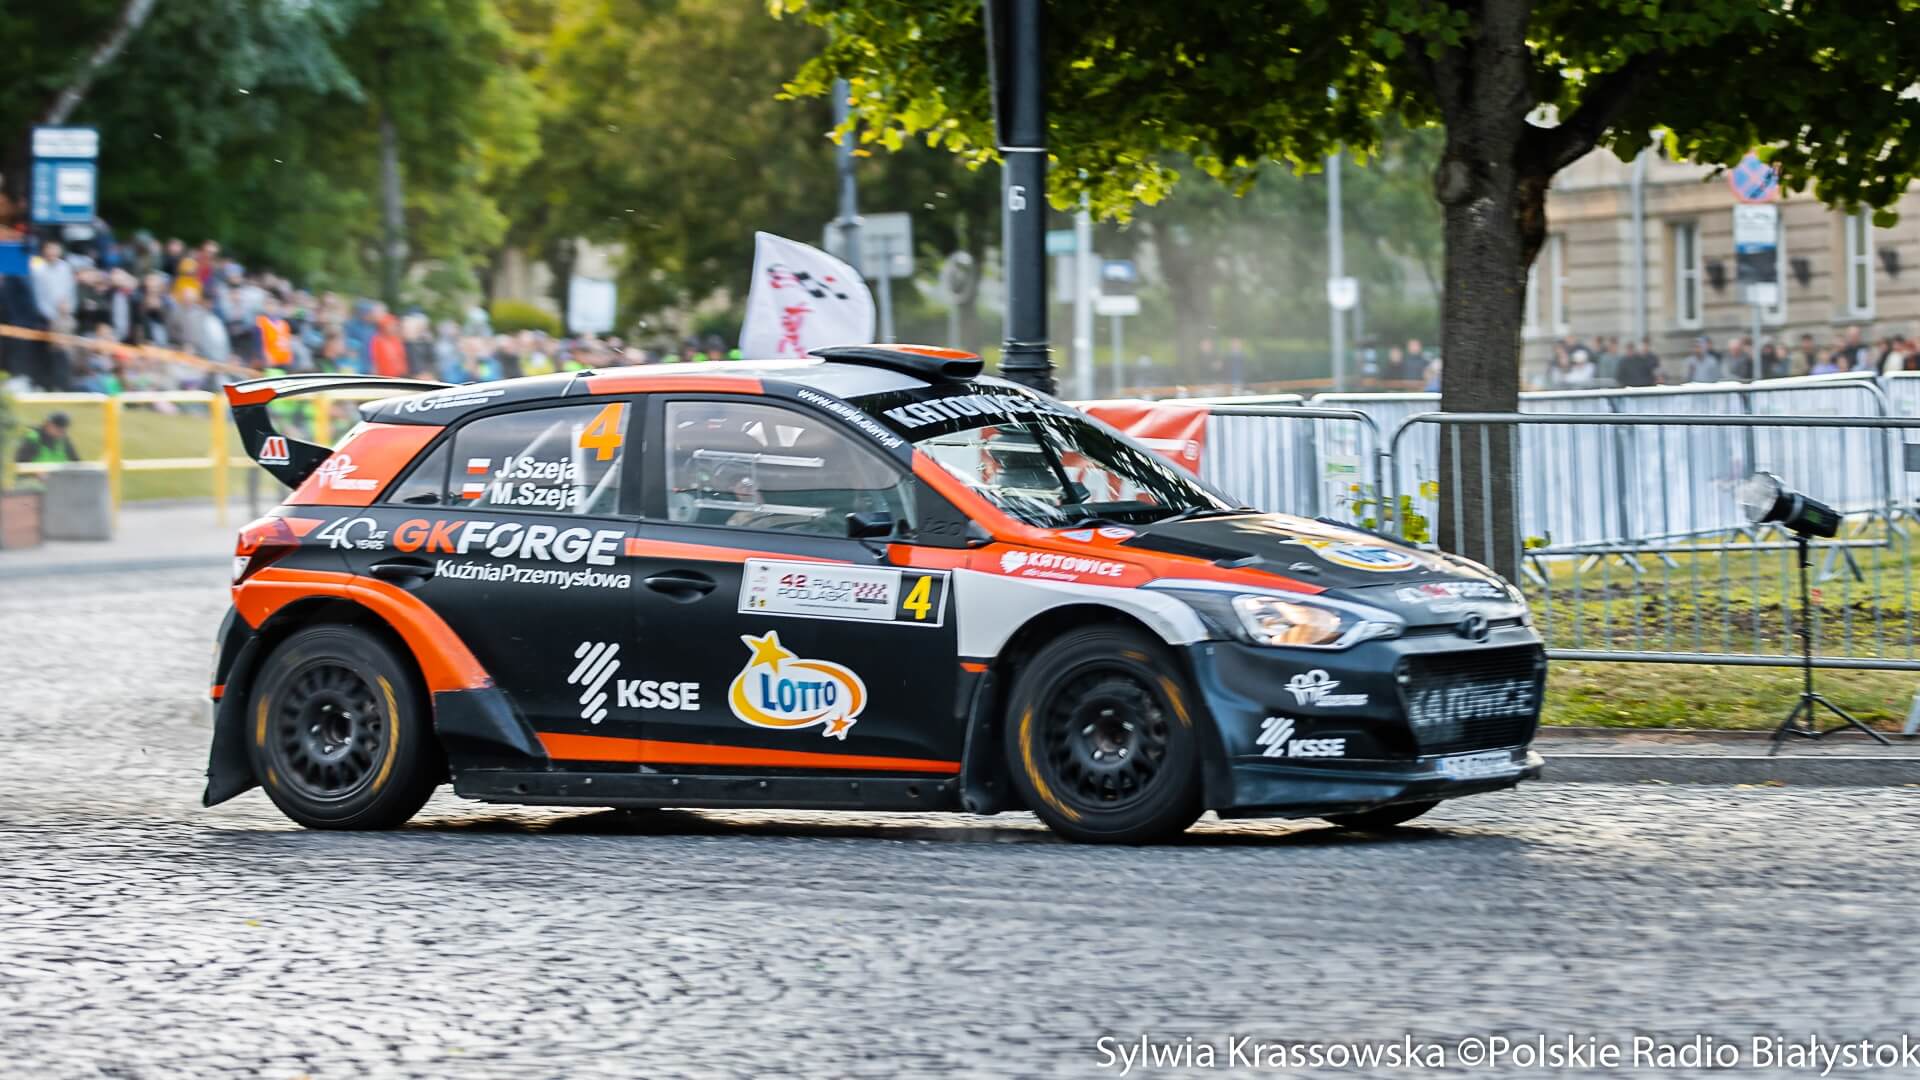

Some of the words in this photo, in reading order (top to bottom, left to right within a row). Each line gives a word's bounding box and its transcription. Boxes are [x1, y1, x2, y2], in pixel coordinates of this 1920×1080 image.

[1008, 185, 1026, 212] 6
[579, 403, 625, 461] 4
[495, 456, 579, 482] J.Szeja
[489, 481, 581, 509] M.Szeja
[392, 518, 626, 566] GKFORGE
[1027, 551, 1126, 577] KATOWICE
[779, 573, 808, 588] 42
[903, 575, 932, 620] 4
[617, 679, 700, 711] KSSE
[759, 671, 837, 712] LOTTO
[1288, 738, 1346, 758] KSSE
